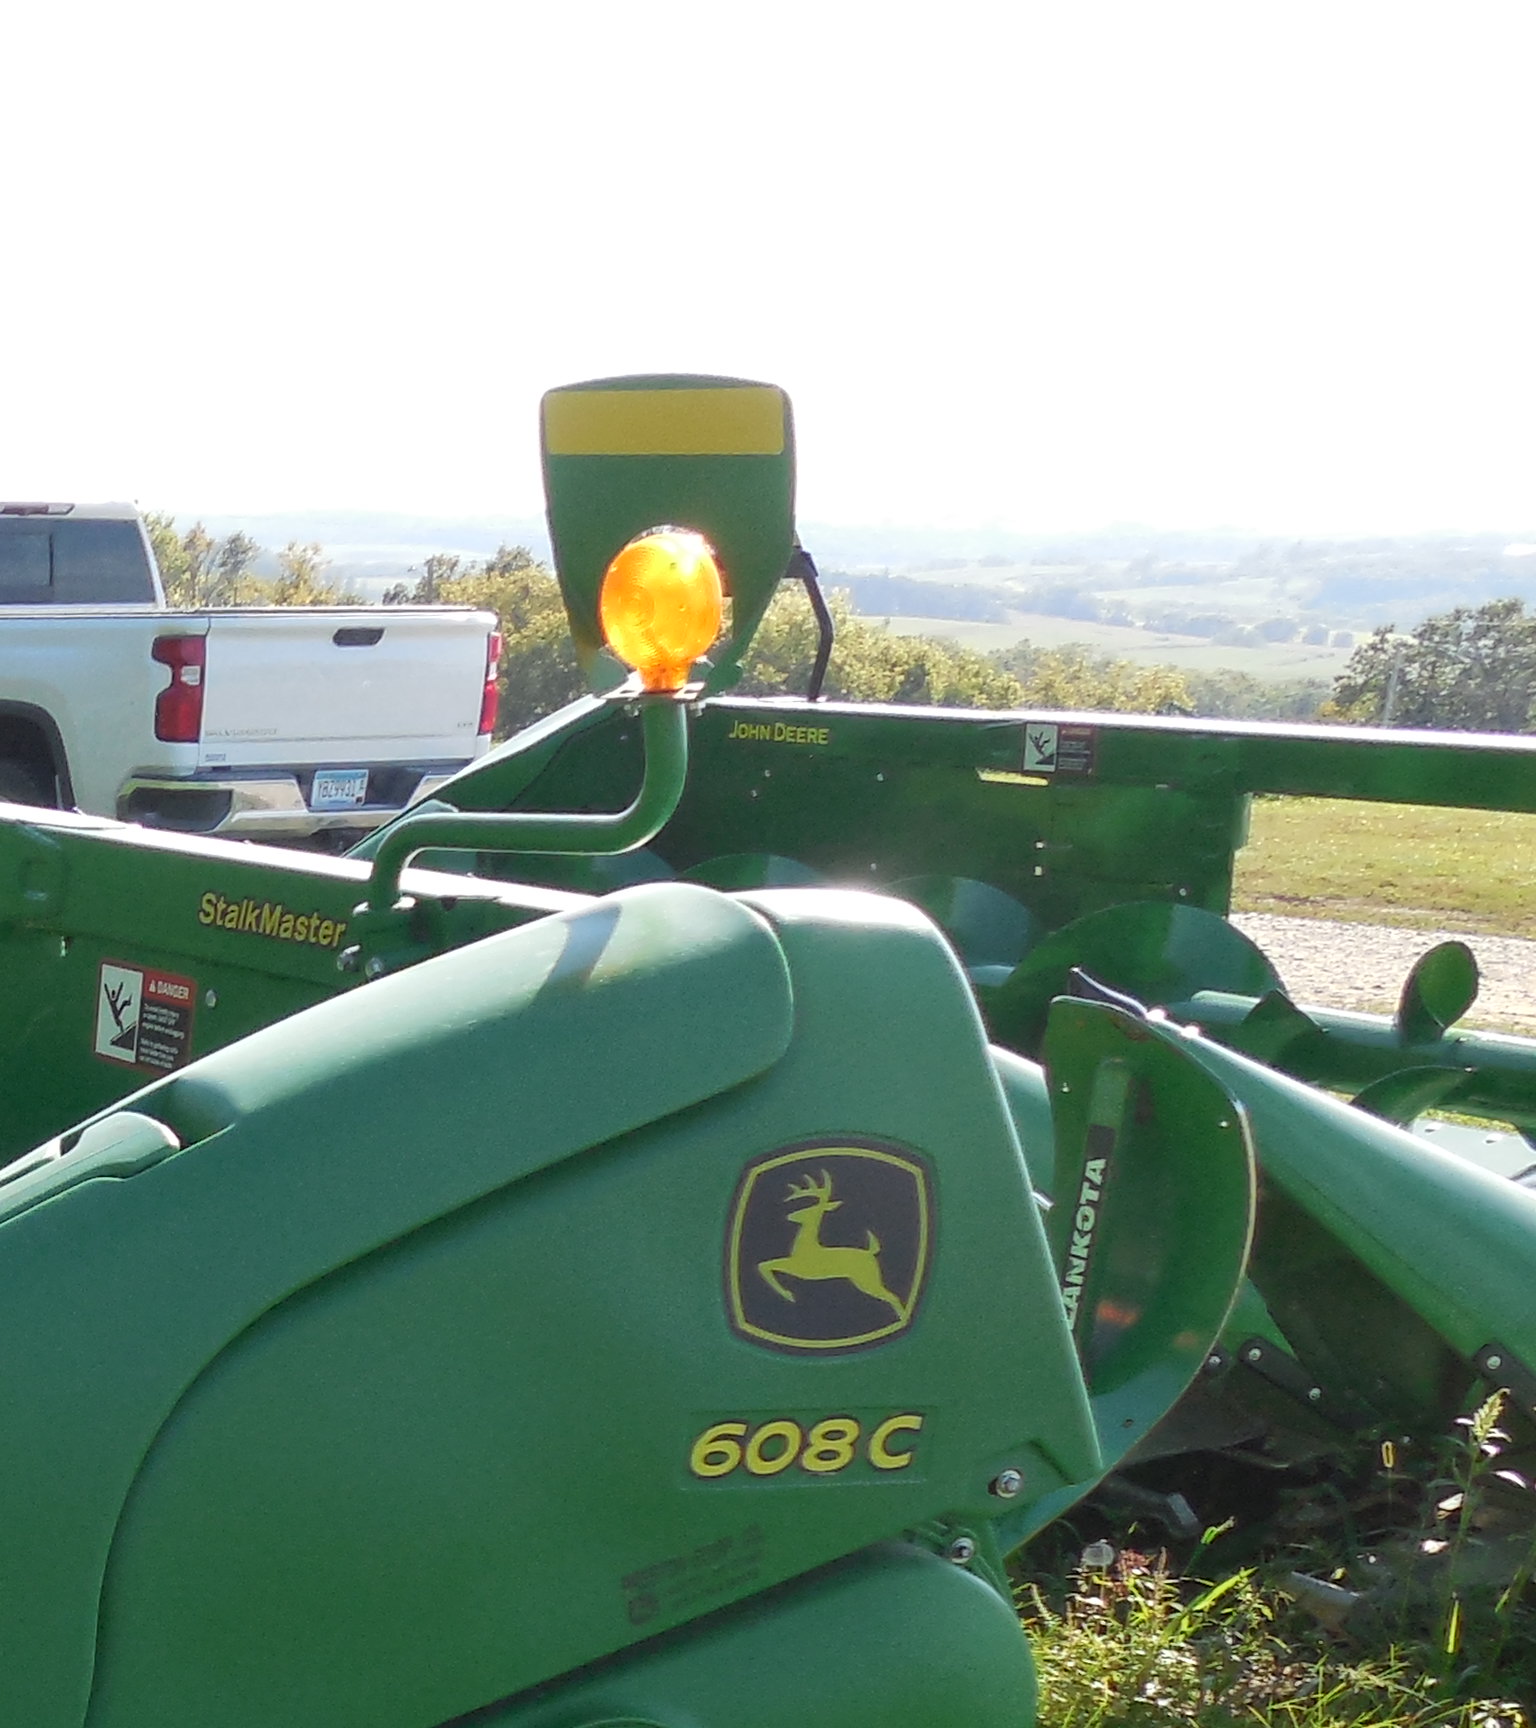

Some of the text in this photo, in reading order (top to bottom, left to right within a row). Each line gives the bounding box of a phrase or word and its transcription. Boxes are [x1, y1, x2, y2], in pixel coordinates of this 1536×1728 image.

[728, 719, 830, 744] JOHN DEERE
[198, 891, 347, 947] StalkMaster
